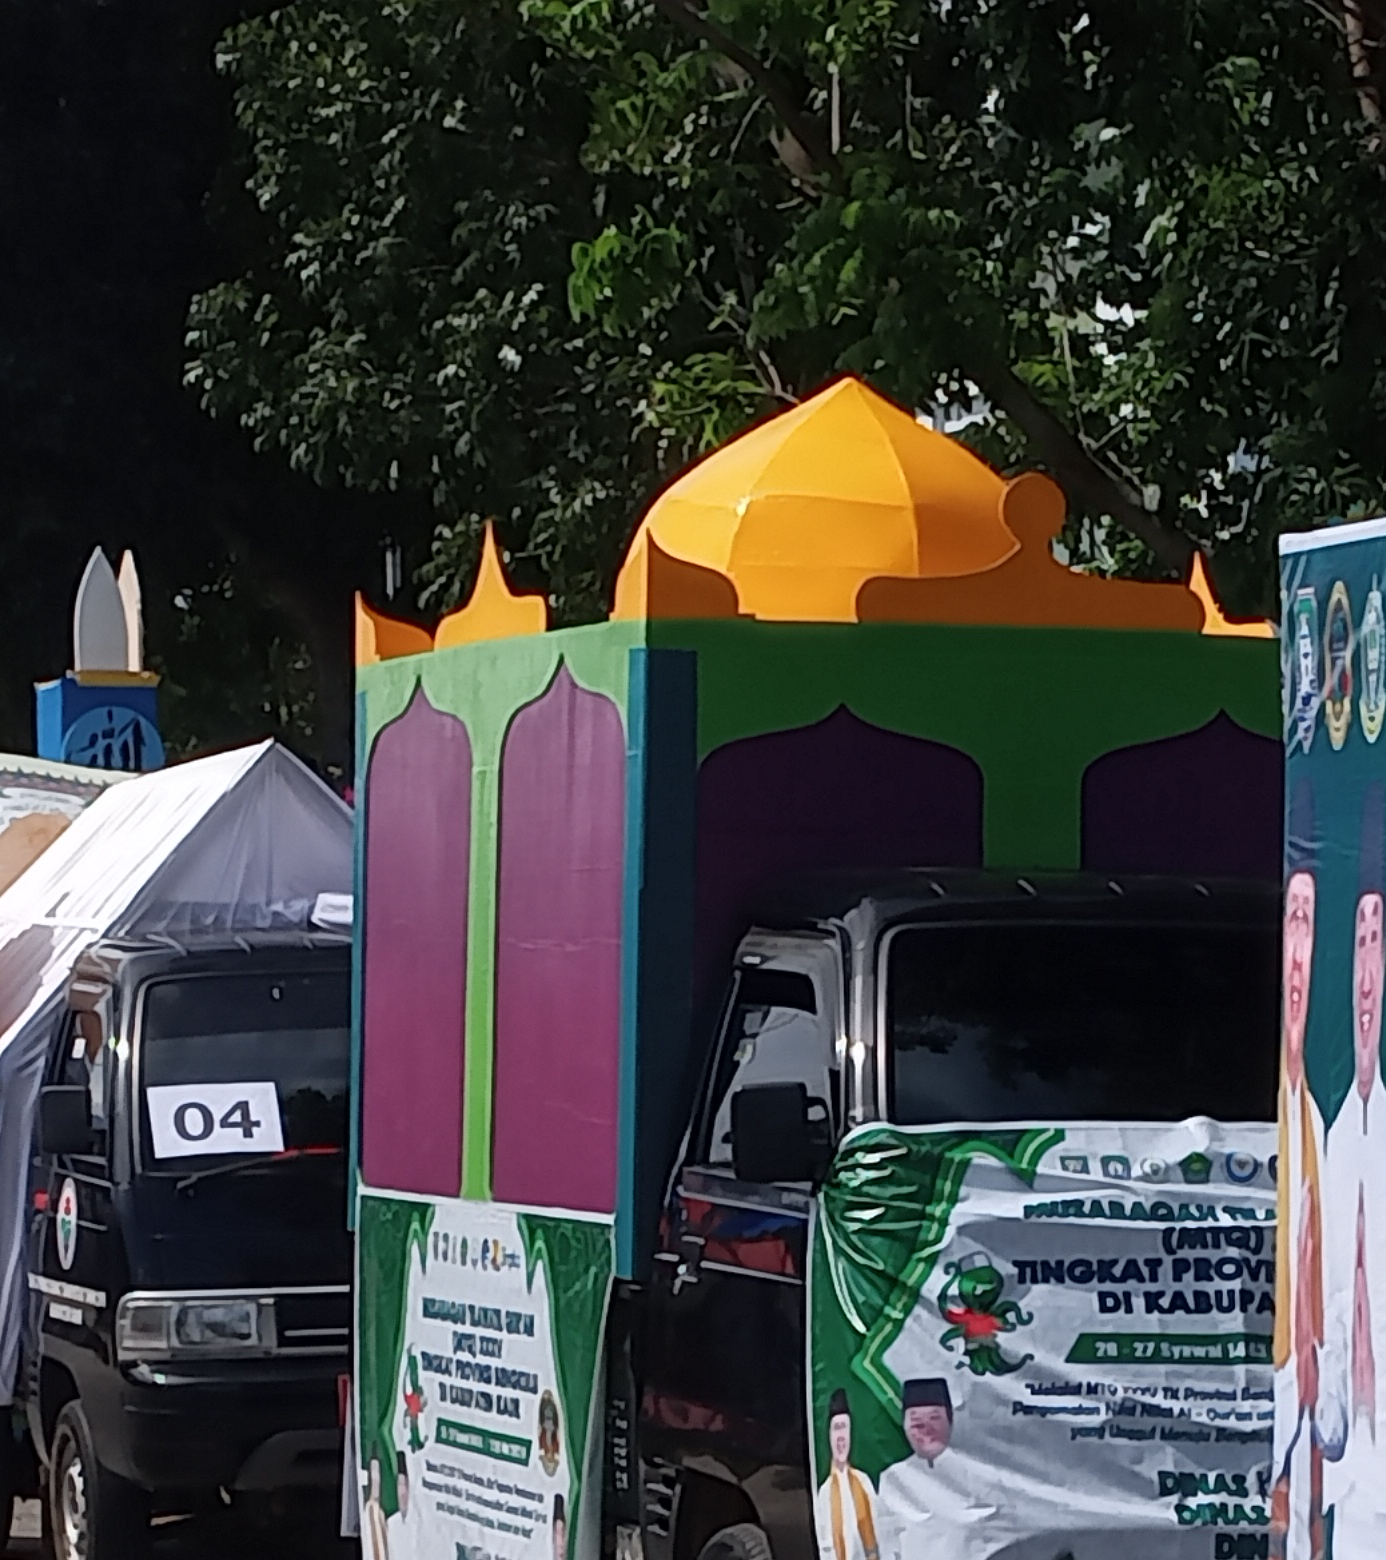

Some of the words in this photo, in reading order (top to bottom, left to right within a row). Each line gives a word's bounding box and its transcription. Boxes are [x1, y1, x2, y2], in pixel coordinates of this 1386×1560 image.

[174, 1100, 261, 1141] 04
[1163, 1226, 1264, 1255] (MTQ)
[1013, 1257, 1163, 1285] TINGKAT
[1097, 1290, 1133, 1315] DI
[1157, 1470, 1249, 1498] DINAS
[1174, 1502, 1272, 1525] DINAS
